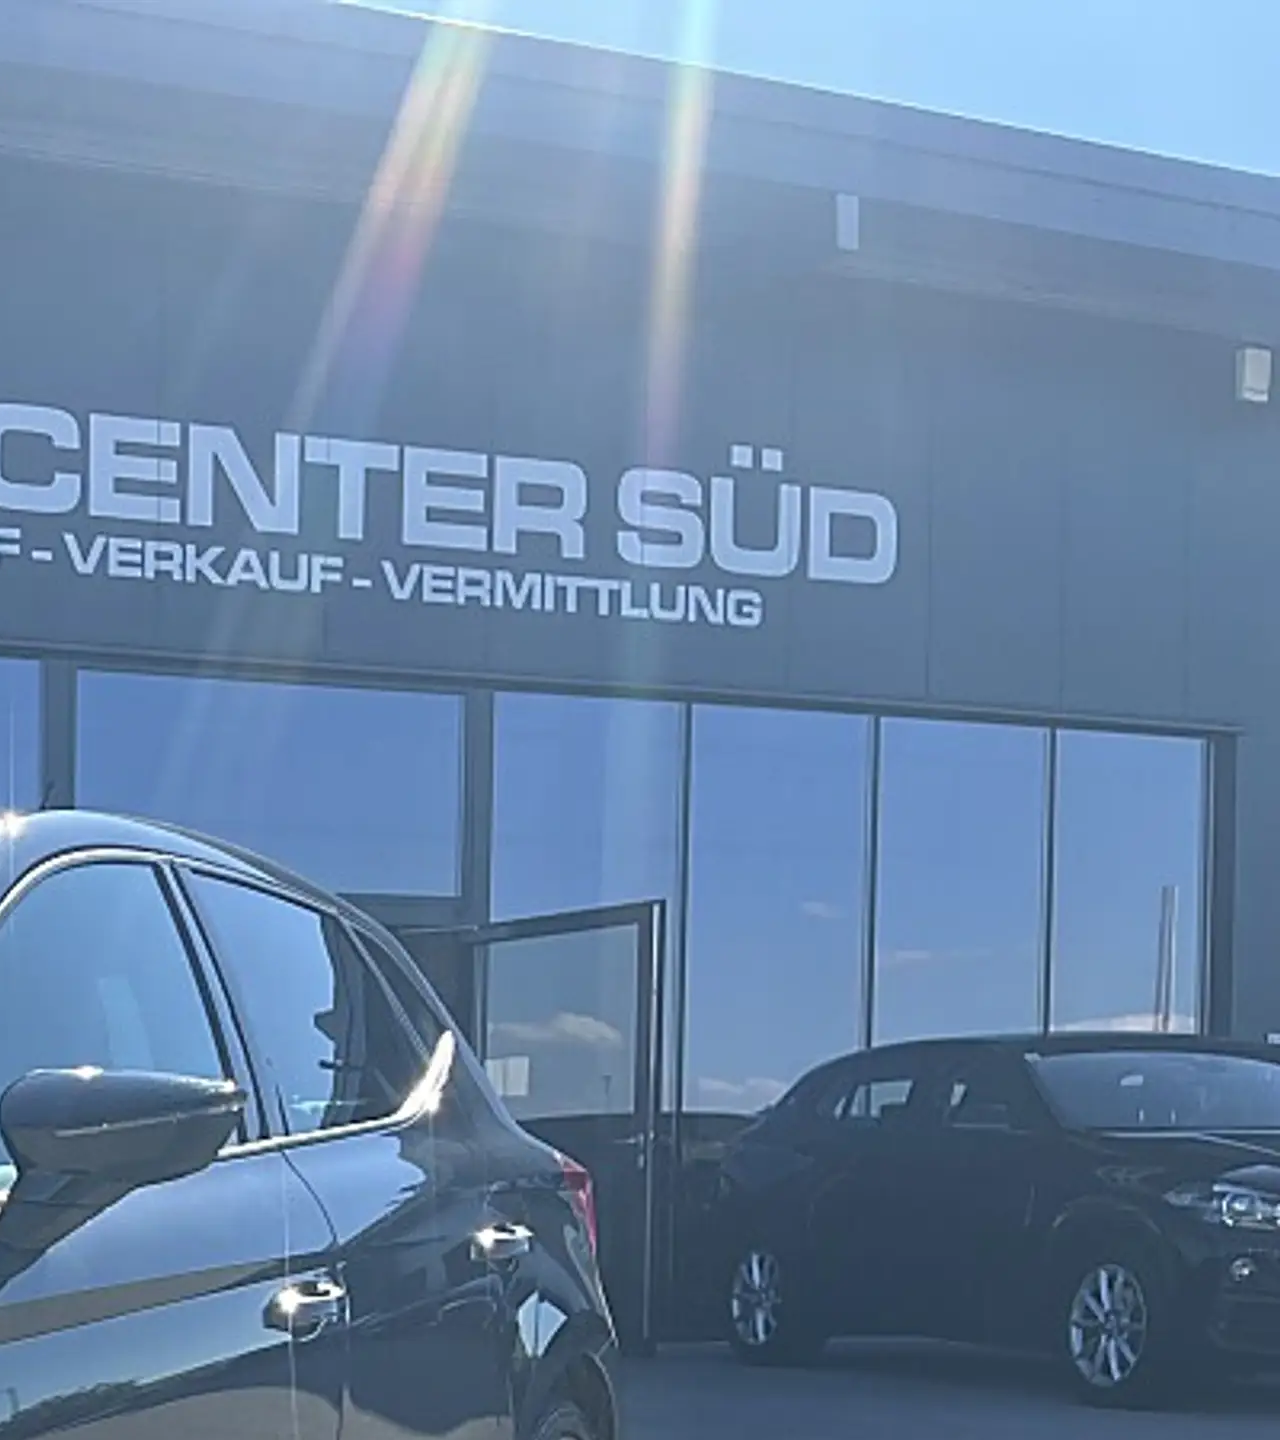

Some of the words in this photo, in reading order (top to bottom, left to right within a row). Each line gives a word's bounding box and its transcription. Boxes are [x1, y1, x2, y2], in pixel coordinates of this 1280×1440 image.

[617, 444, 898, 584] SÜD
[63, 532, 343, 594] VERKAUF
[381, 560, 764, 628] VERMITTLUNG
